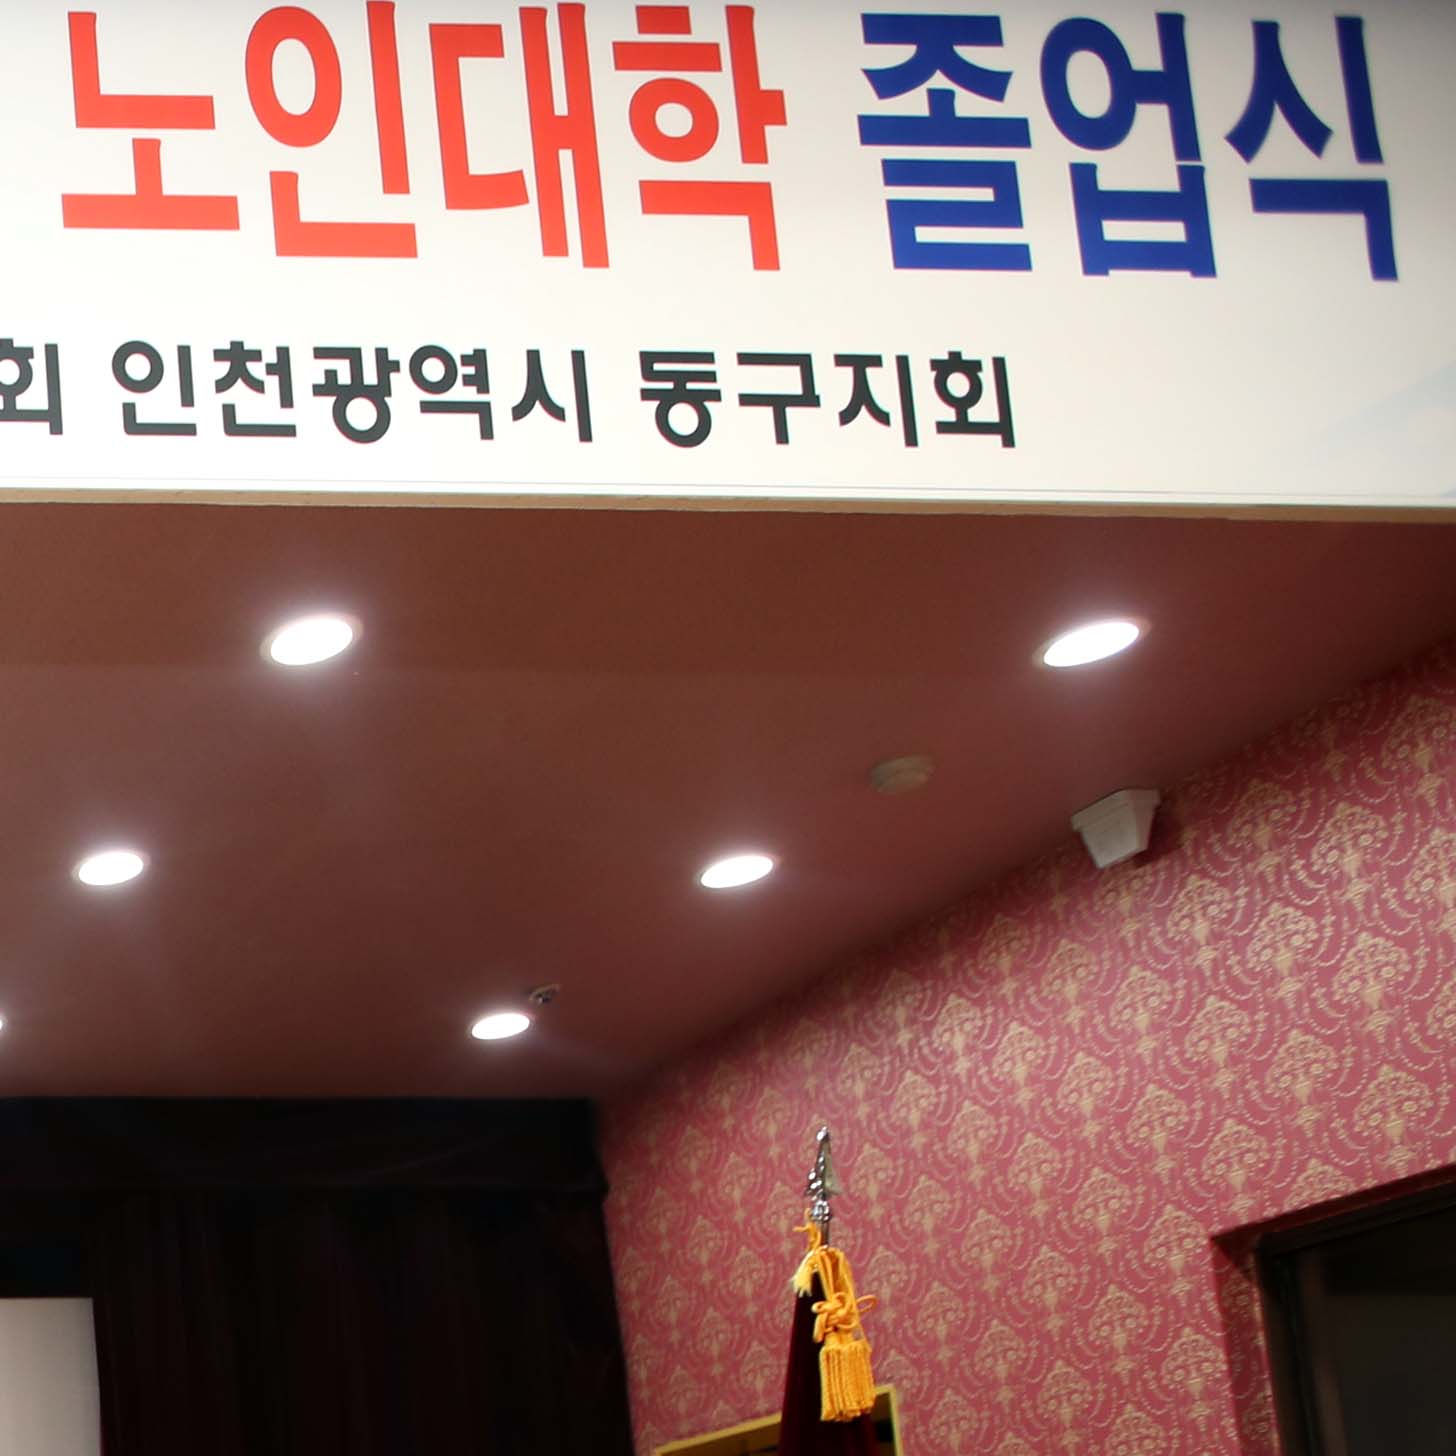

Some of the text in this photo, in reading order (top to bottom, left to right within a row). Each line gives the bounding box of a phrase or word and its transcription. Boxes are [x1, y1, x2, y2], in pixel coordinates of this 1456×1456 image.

[64, 0, 787, 270] 노인대학
[859, 12, 1397, 279] 졸업식
[112, 341, 592, 443] 인천광역시
[640, 351, 1015, 447] 동구지회
